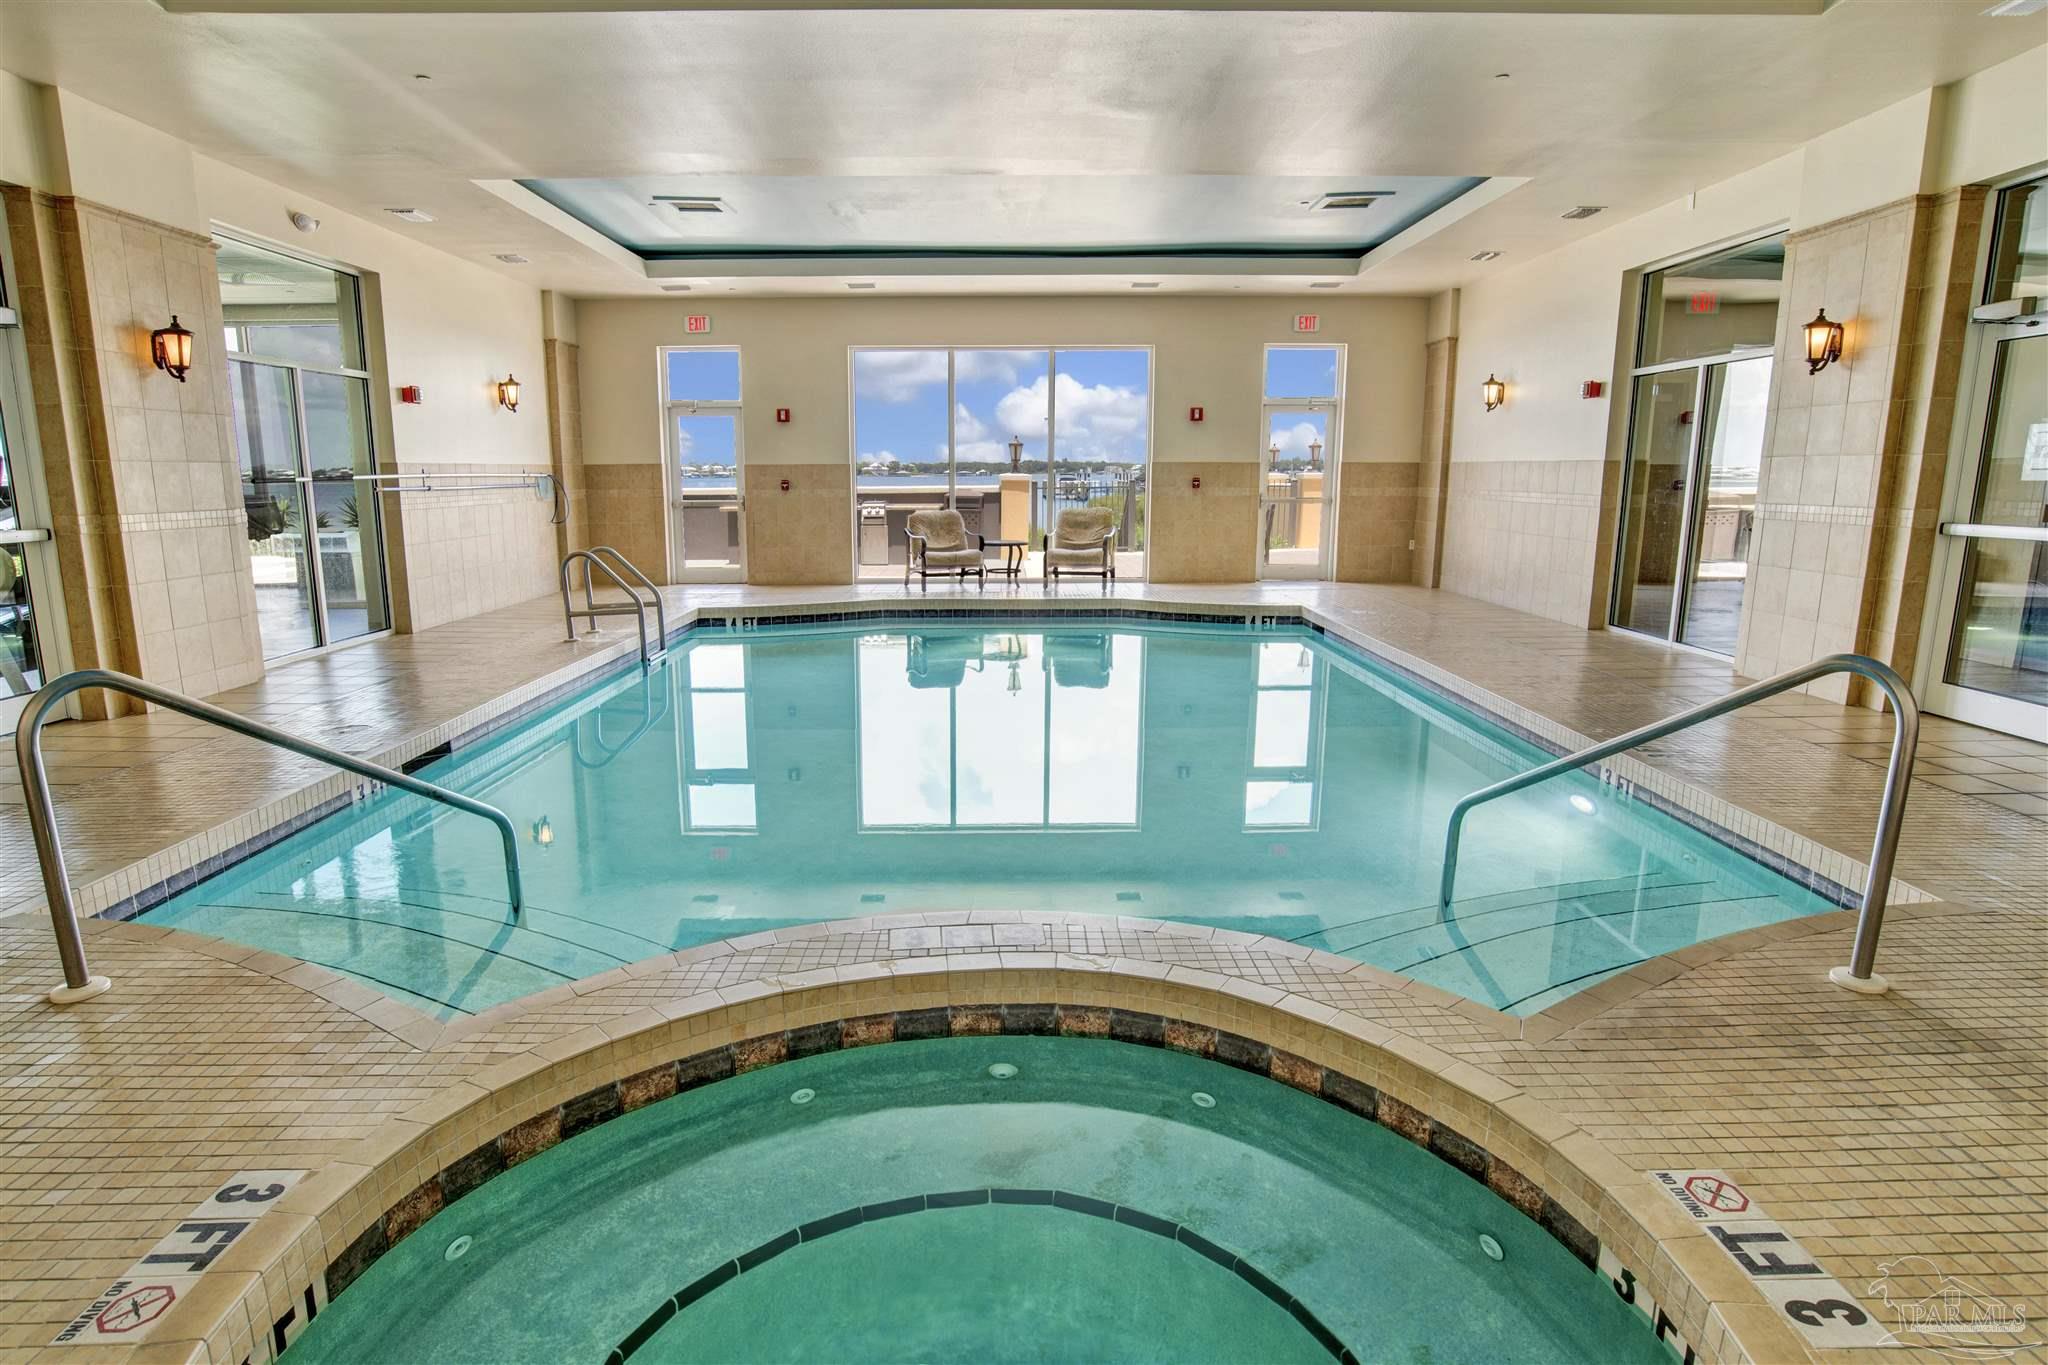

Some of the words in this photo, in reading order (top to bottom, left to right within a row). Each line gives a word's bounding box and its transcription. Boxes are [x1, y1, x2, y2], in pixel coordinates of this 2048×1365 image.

[688, 316, 707, 331] EXIT
[1299, 315, 1318, 330] EXIT
[742, 616, 756, 626] FT
[1261, 615, 1275, 625] FT
[1605, 768, 1613, 784] 3
[1616, 774, 1633, 795] FT
[214, 1183, 286, 1203] 3
[1655, 1172, 1678, 1185] NO
[1669, 1187, 1709, 1218] DIVING
[140, 1221, 252, 1272] FT
[1706, 1225, 1825, 1276] FT
[104, 1280, 133, 1297] NO
[54, 1300, 111, 1342] DIVING
[1784, 1299, 1868, 1327] 3
